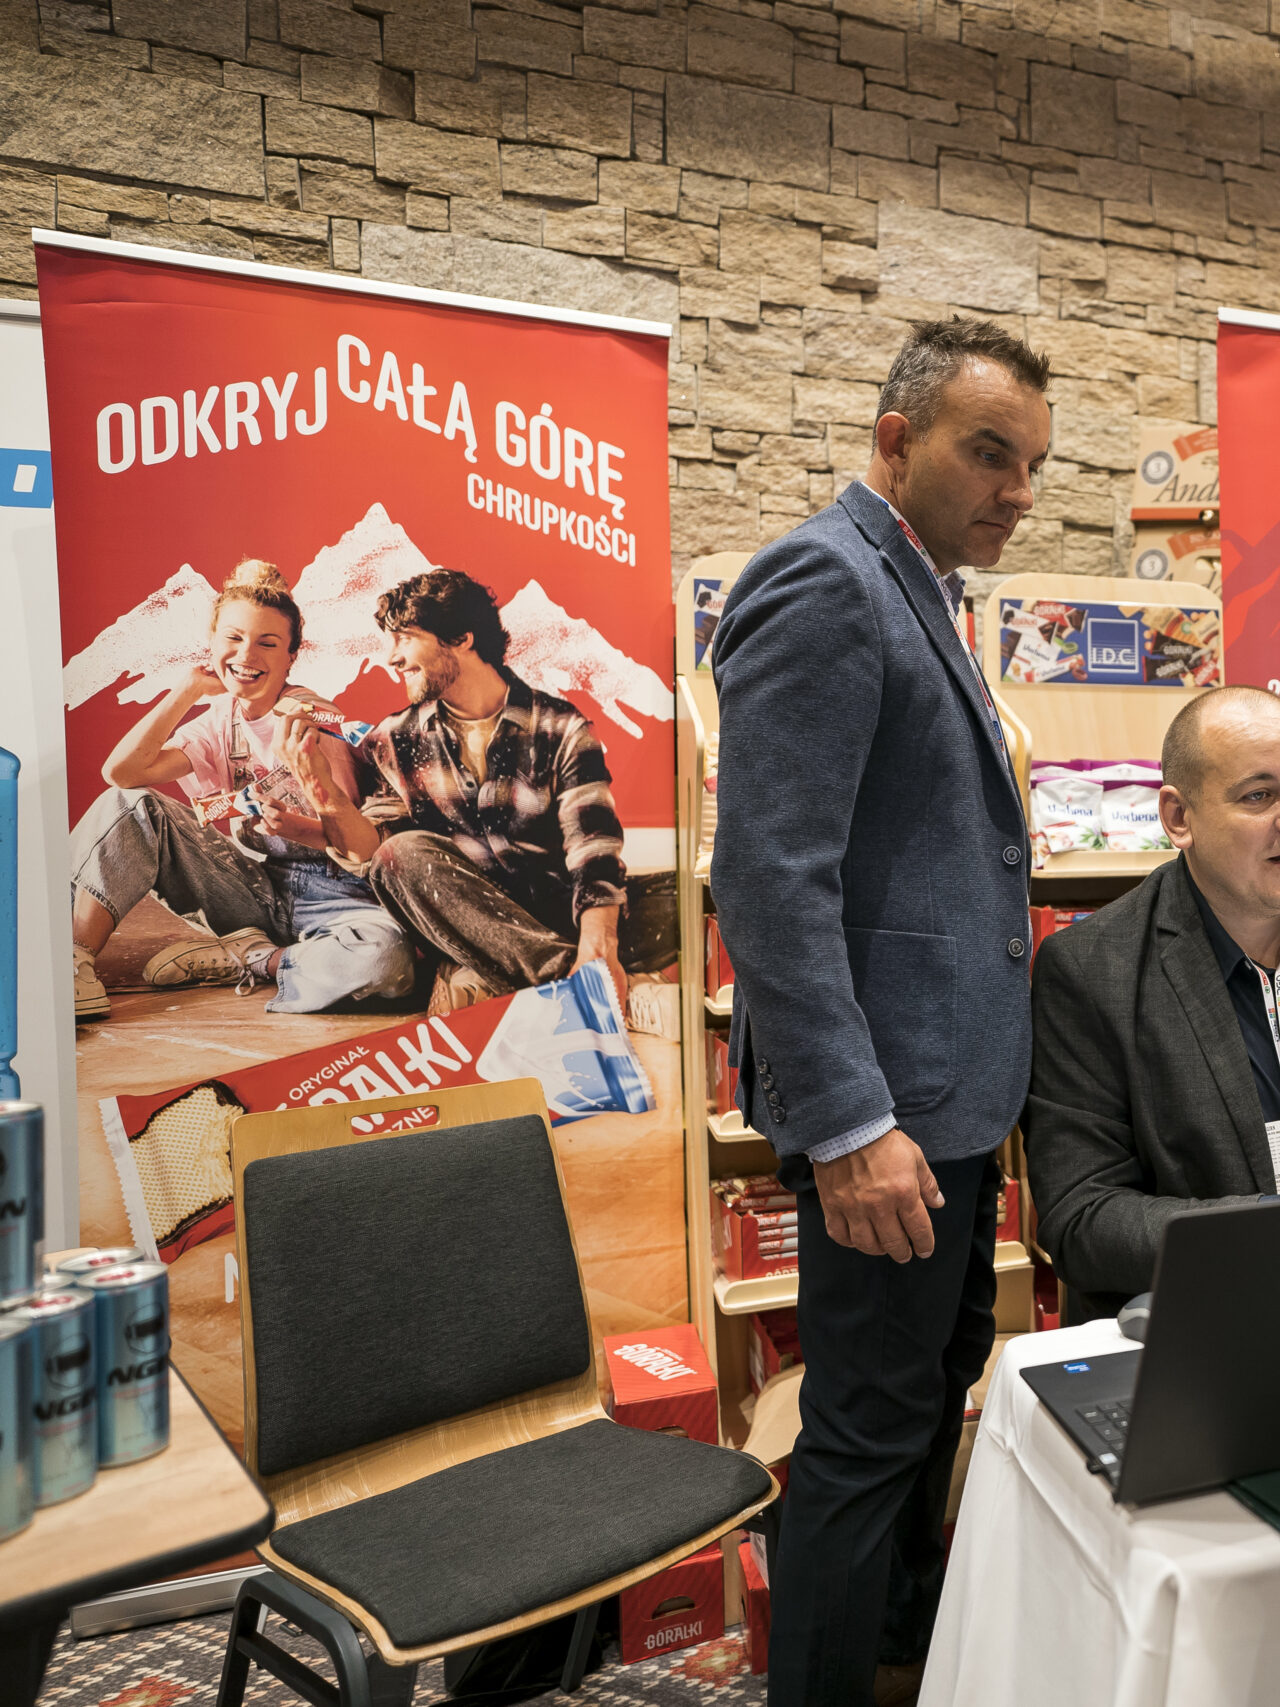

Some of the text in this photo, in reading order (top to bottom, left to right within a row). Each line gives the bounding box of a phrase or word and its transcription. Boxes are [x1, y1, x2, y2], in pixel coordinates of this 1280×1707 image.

[97, 333, 626, 520] ODKRYJ CAŁĄ GÓRĘ
[467, 473, 636, 567] CHRUPKOŚCI
[289, 1045, 370, 1101] ORYGINAŁ
